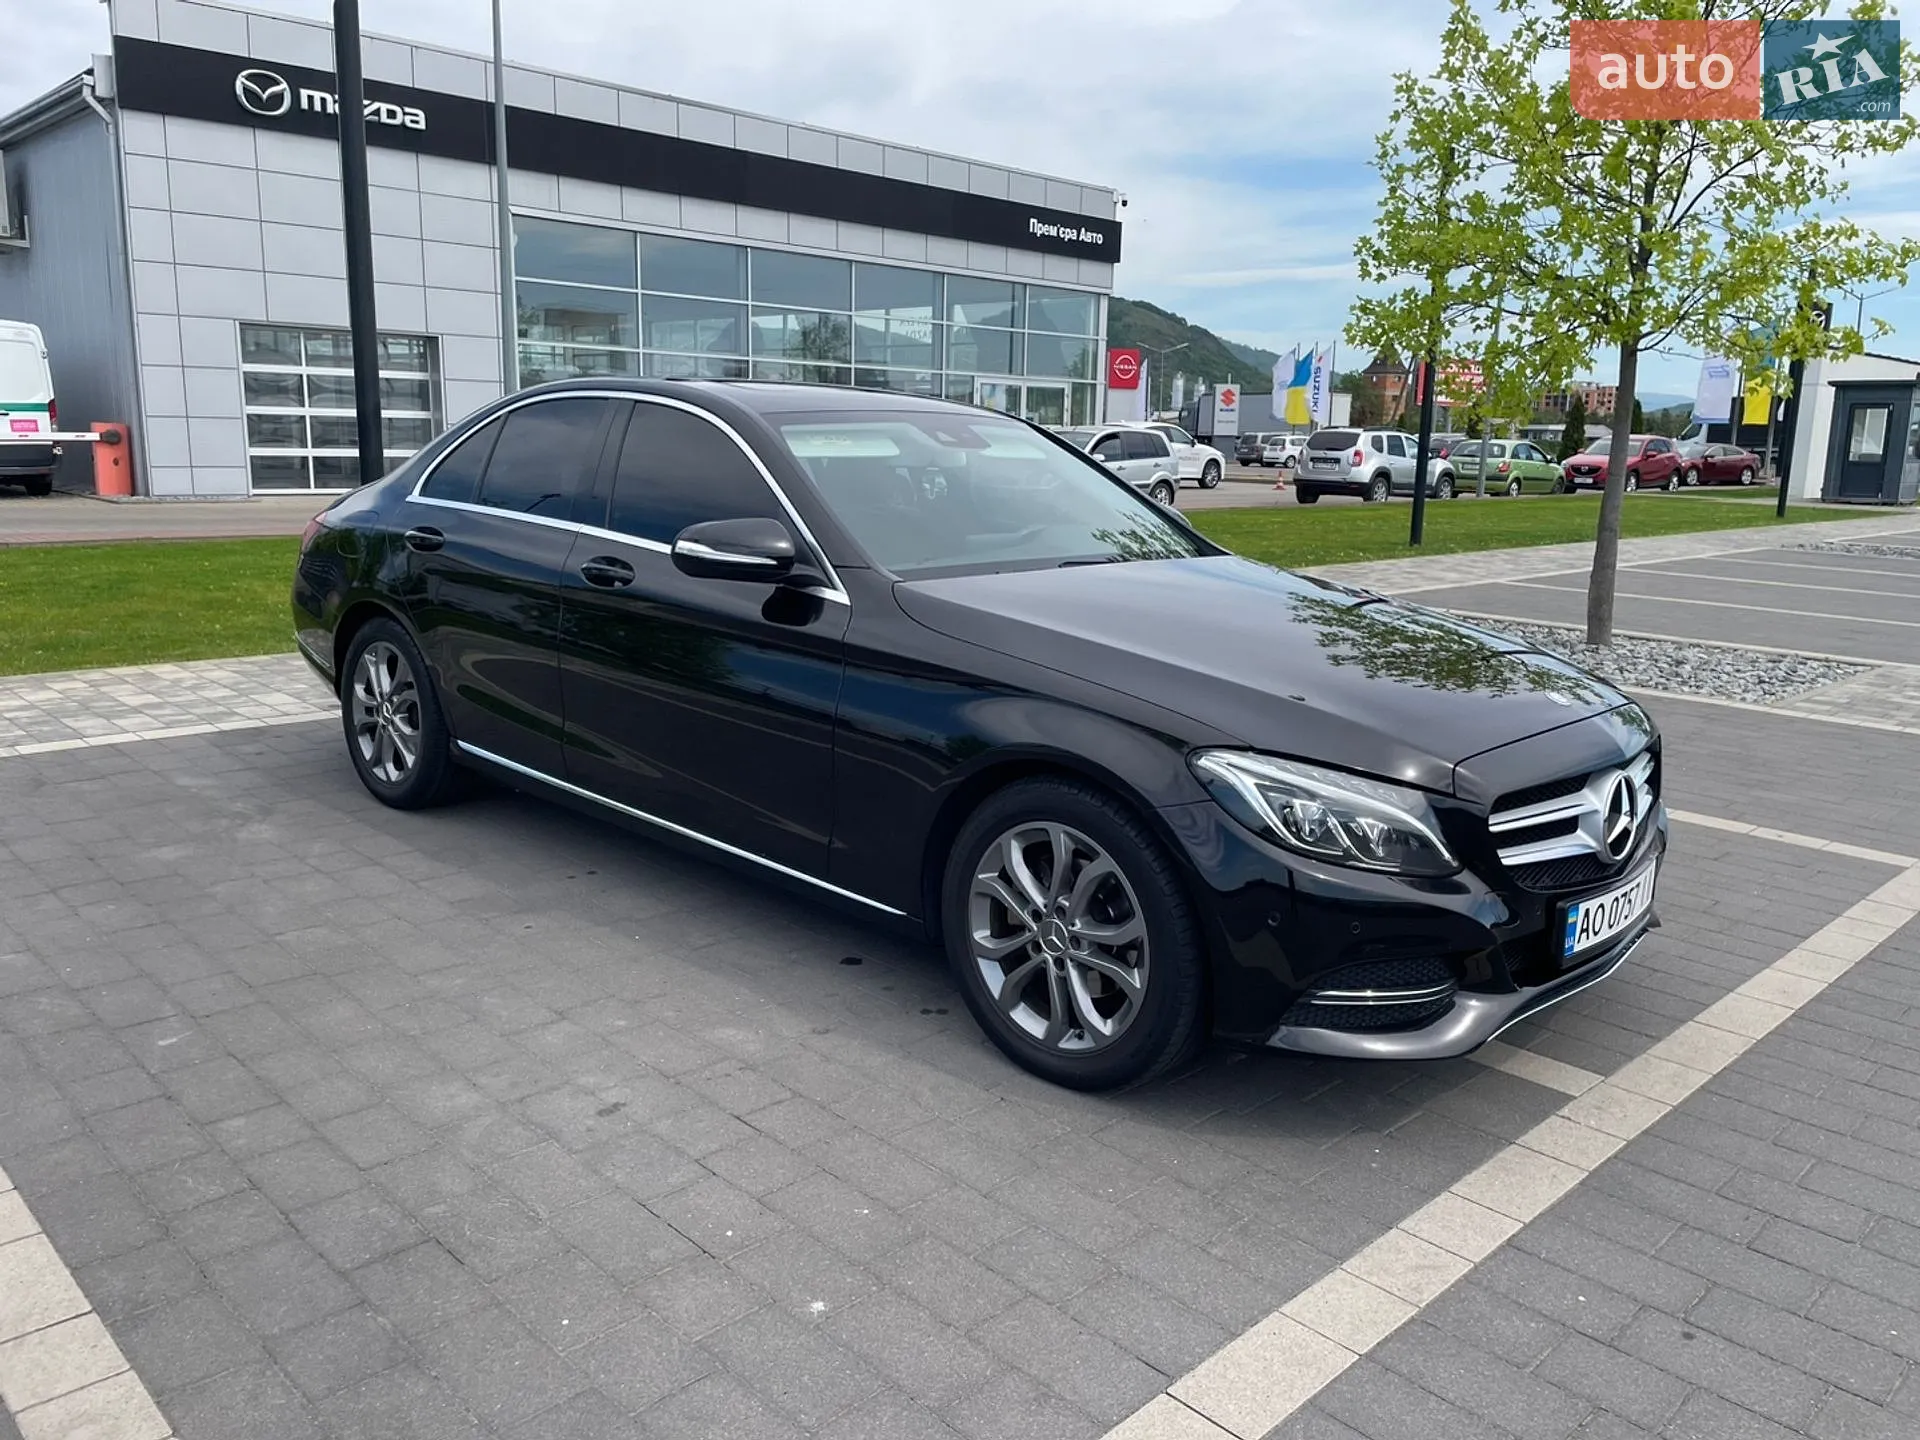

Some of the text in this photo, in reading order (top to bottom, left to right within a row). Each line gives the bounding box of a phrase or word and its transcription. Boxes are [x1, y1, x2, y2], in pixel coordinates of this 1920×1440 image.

[299, 88, 427, 130] mzda
[1079, 227, 1104, 244] Авто
[1311, 366, 1322, 413] SUZUKI
[1577, 902, 1605, 944] AO
